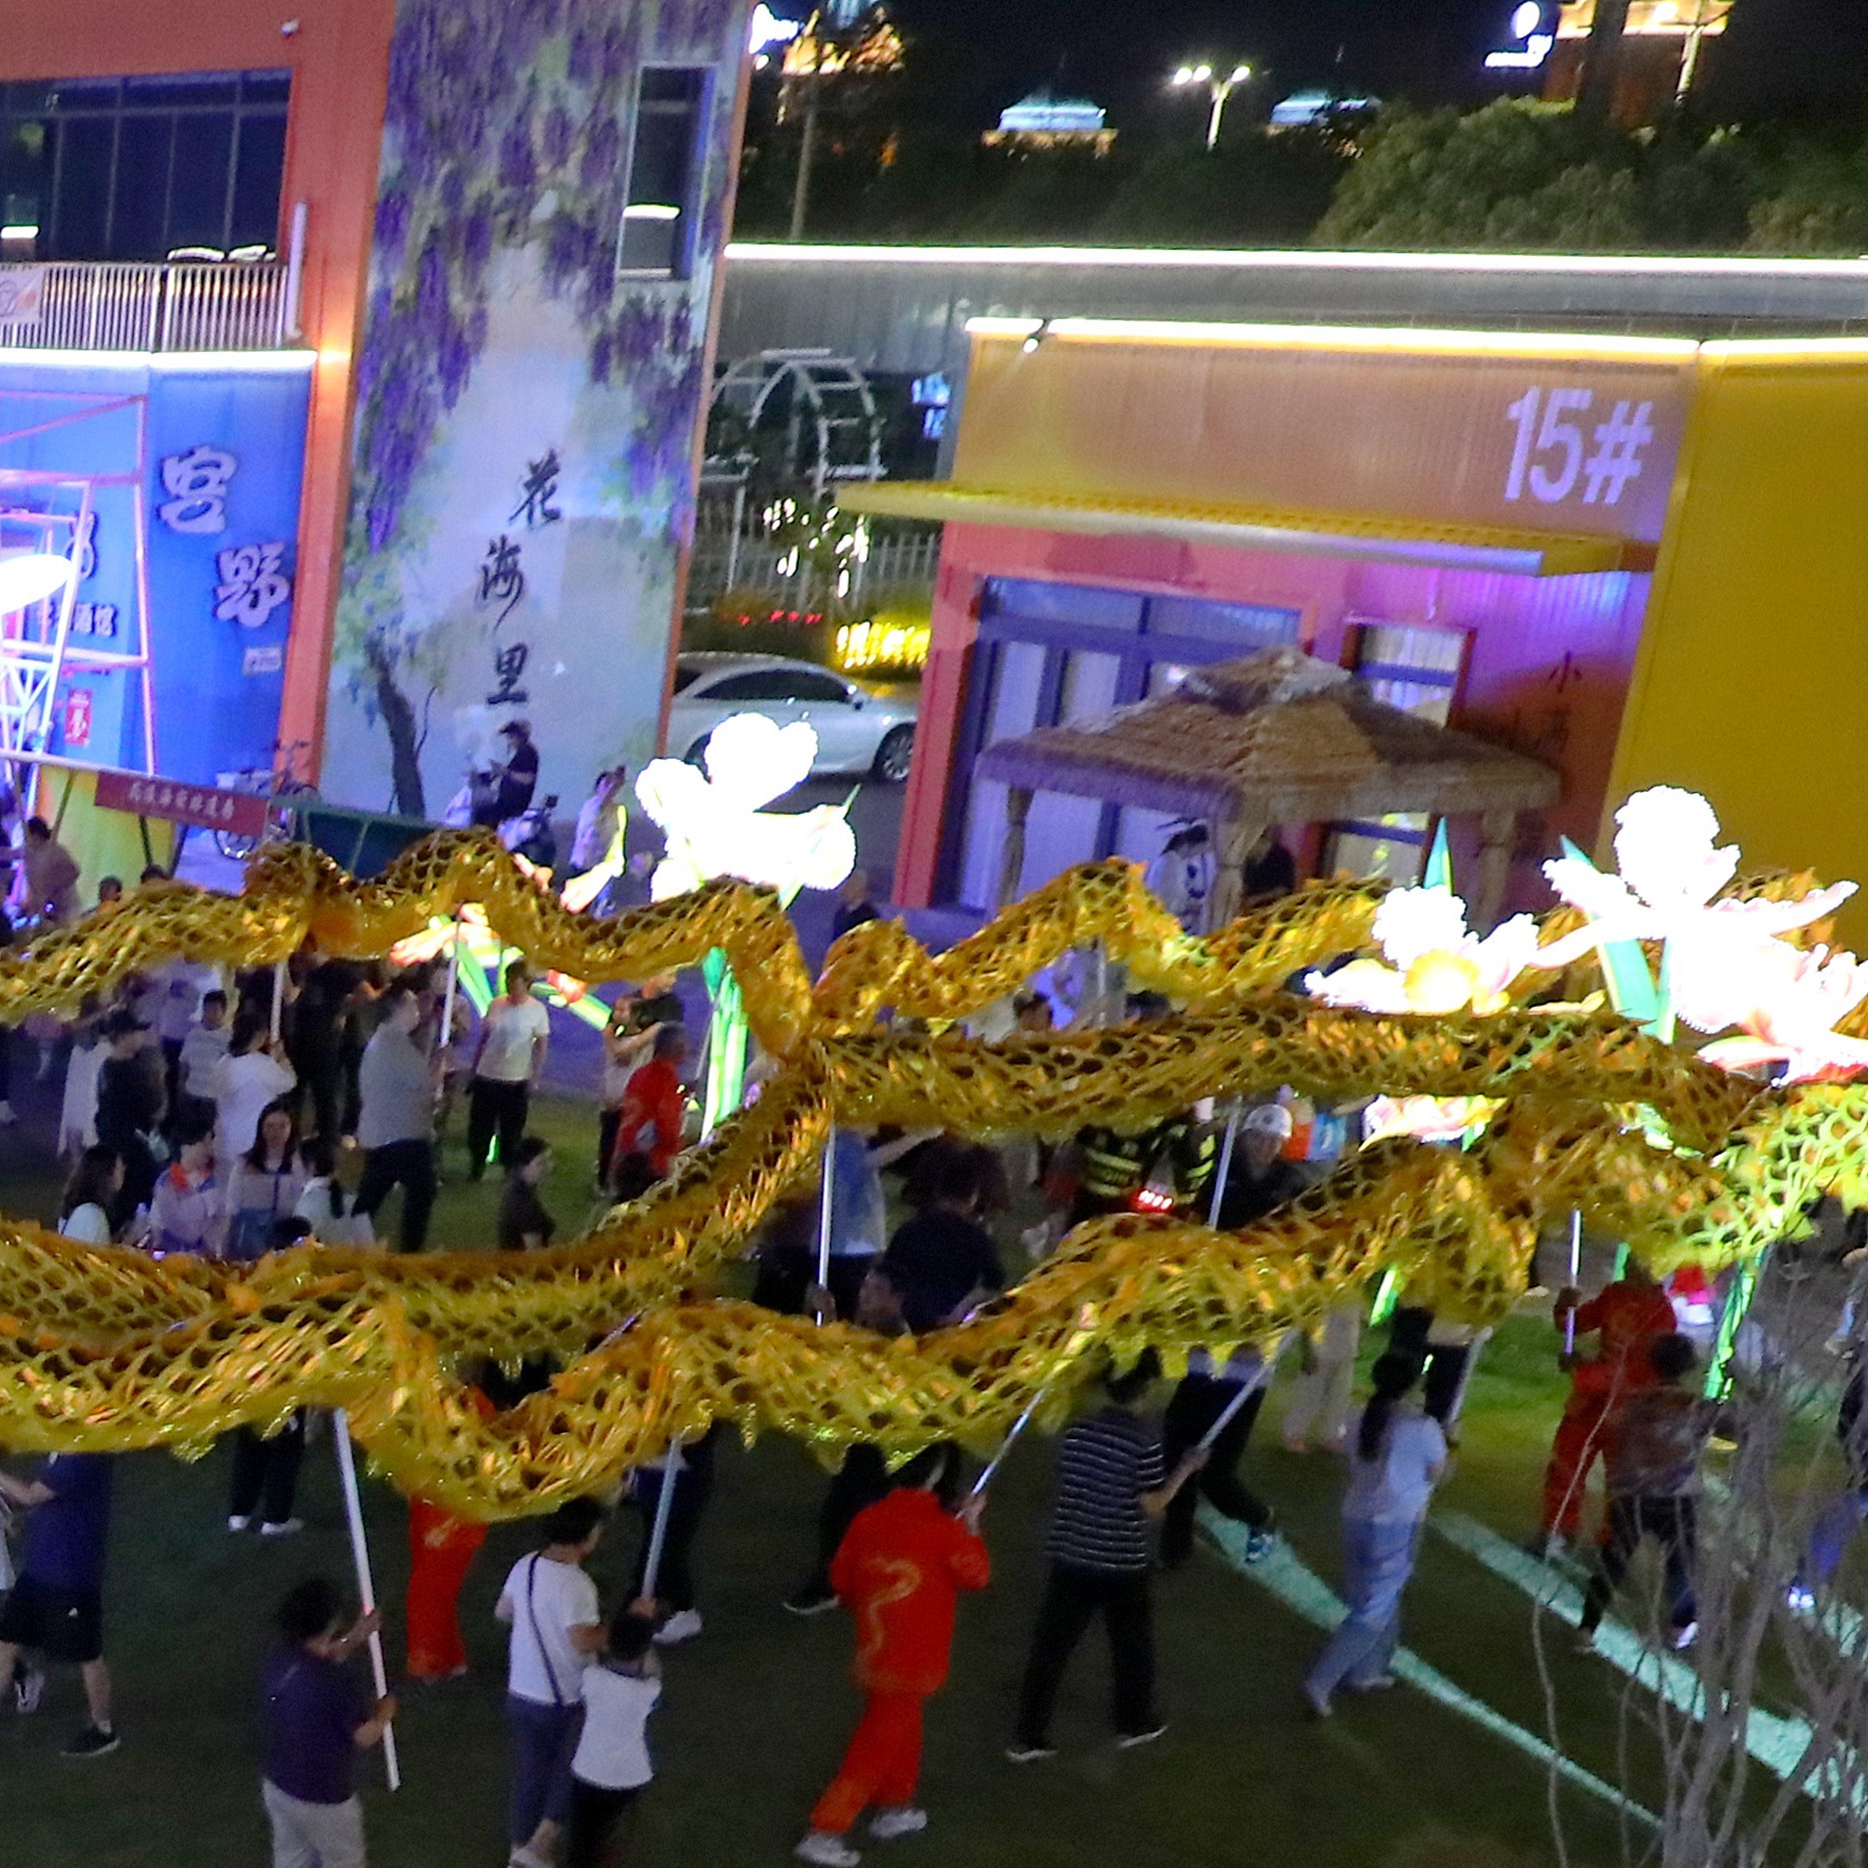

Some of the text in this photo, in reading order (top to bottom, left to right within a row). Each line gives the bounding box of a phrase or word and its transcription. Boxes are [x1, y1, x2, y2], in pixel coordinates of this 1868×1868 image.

[1504, 385, 1654, 504] 15#
[475, 448, 562, 705] 花海里
